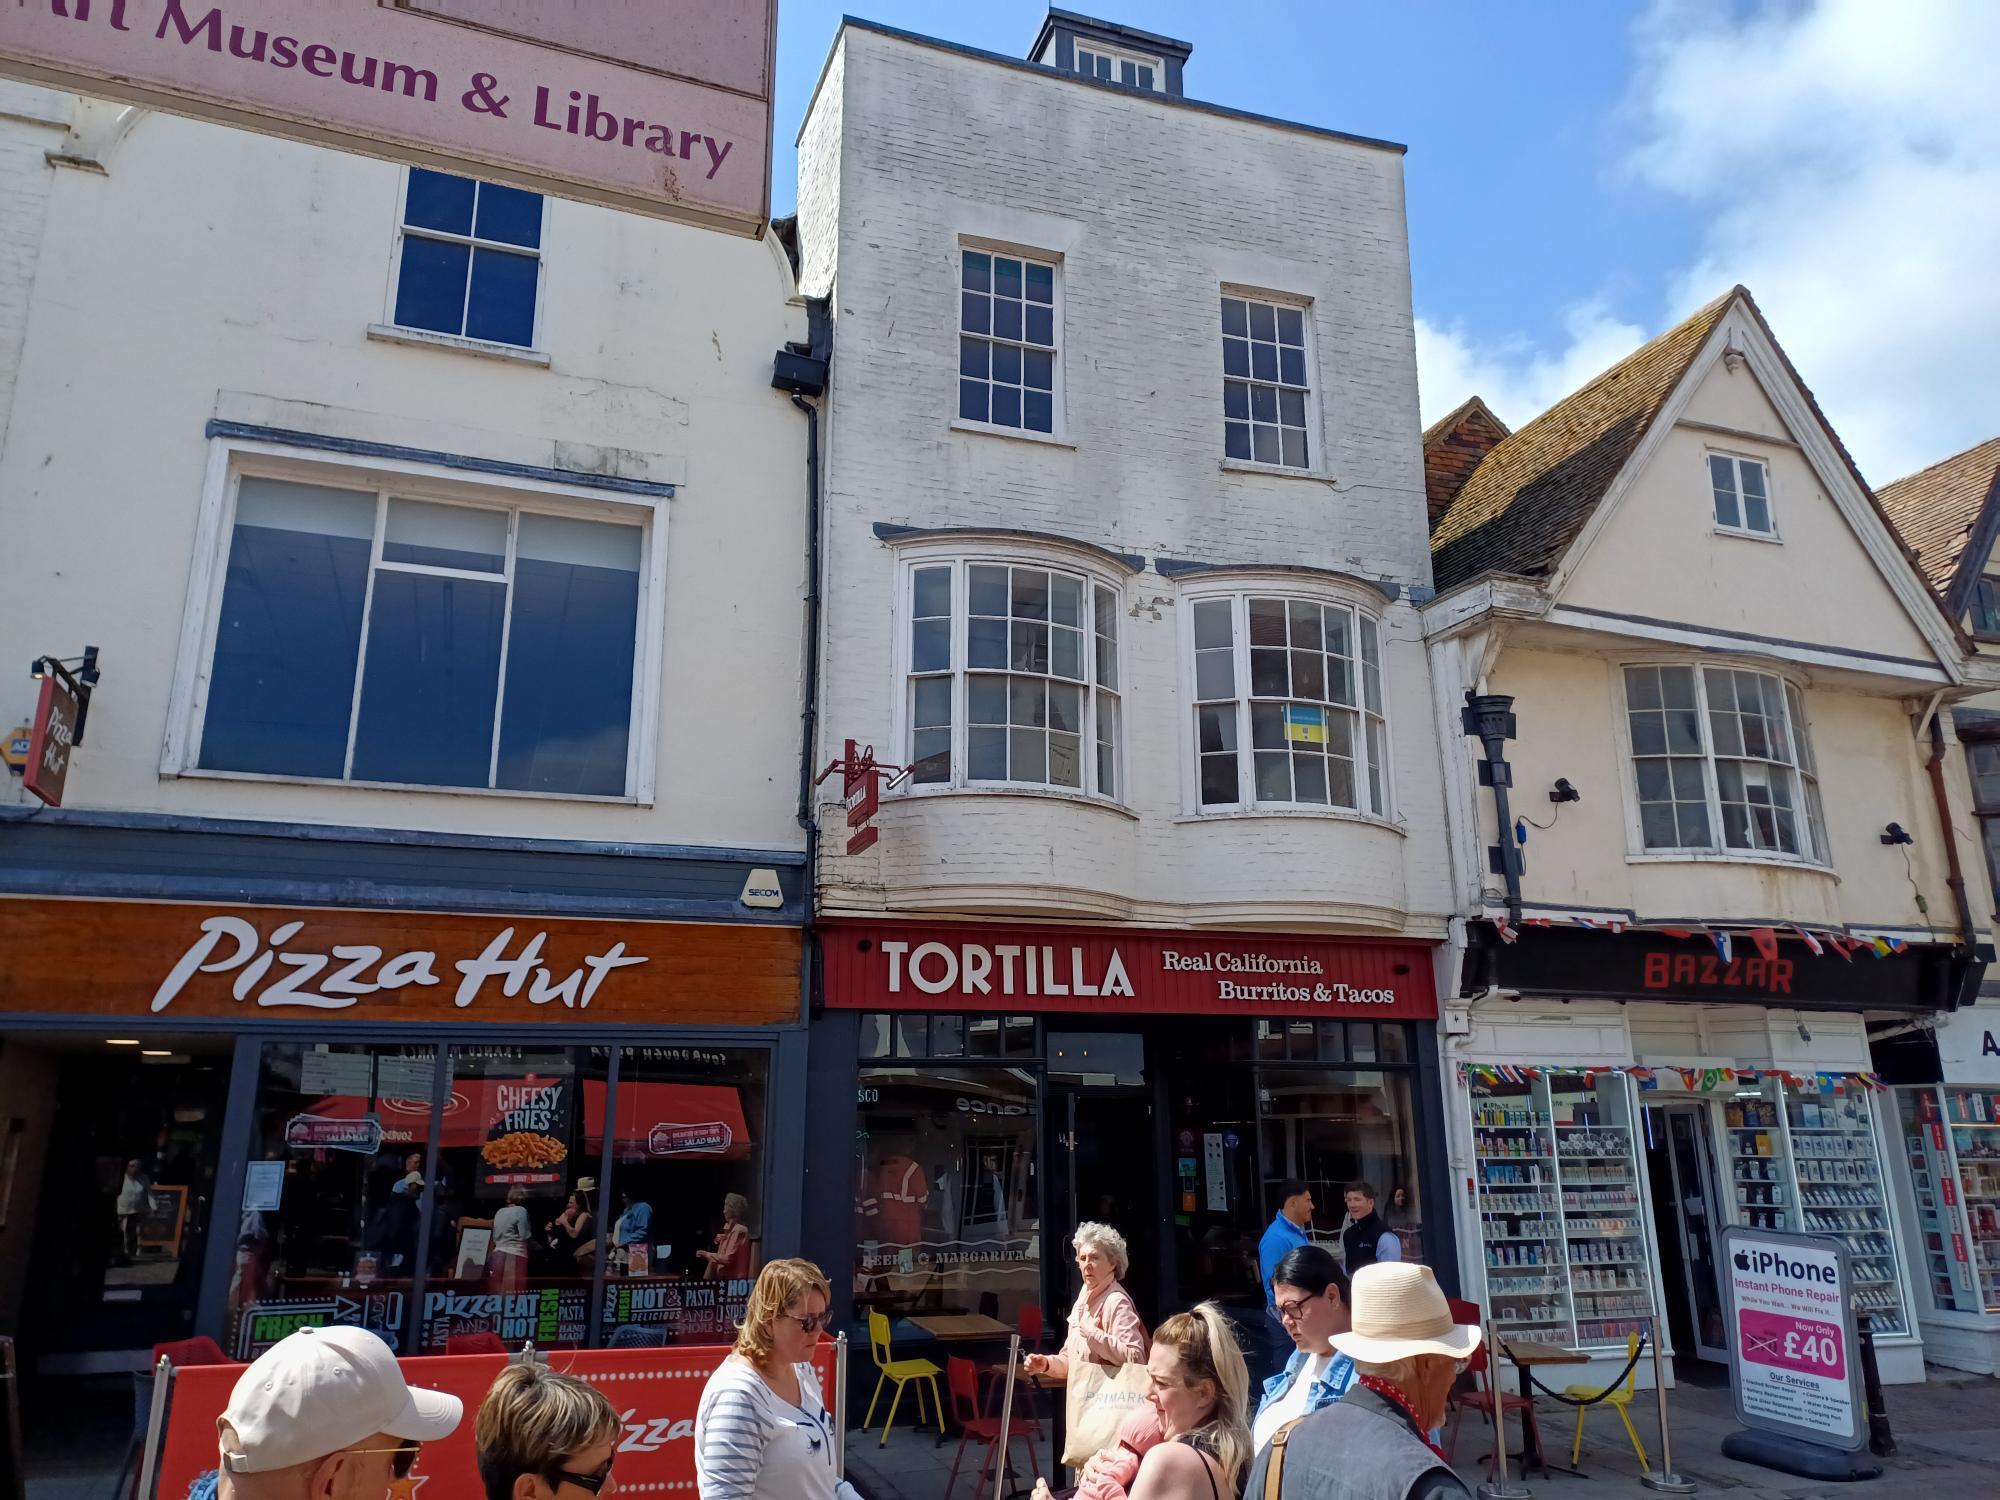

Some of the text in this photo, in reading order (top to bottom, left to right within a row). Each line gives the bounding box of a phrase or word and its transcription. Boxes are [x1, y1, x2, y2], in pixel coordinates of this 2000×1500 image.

[155, 0, 438, 102] Museum
[460, 72, 510, 118] &
[533, 86, 733, 180] Library
[46, 706, 73, 746] Pizza
[43, 741, 65, 776] Hut
[748, 888, 779, 898] SECOM
[151, 916, 650, 1012] Pizza Hut
[882, 941, 1135, 997] TORTILLA
[1162, 950, 1323, 975] Real California
[1645, 952, 1793, 993] BAZZAR
[1218, 981, 1395, 1005] Burritos & Tacos
[497, 1085, 563, 1111] CHEESY
[504, 1109, 552, 1132] FRIES
[1752, 1250, 1836, 1284] iPhone
[631, 1288, 667, 1309] HOT
[685, 1289, 715, 1307] PASTA
[1735, 1278, 1840, 1303] Instant Phone Repair
[424, 1289, 503, 1318] Pizza
[504, 1294, 540, 1318] EAT
[538, 1289, 560, 1341] FRESH
[558, 1306, 585, 1321] PASTA
[602, 1284, 618, 1323] Pizza
[617, 1289, 631, 1322] FRESH
[253, 1312, 325, 1341] FRESH
[453, 1318, 490, 1334] AND
[502, 1317, 538, 1339] HOT
[631, 1311, 681, 1322] DELICIOUS
[682, 1309, 714, 1323] AND
[558, 1332, 586, 1341] MADE
[559, 1325, 587, 1334] HAND
[1795, 1321, 1835, 1338] Now Only
[1783, 1331, 1838, 1367] £40
[1769, 1371, 1820, 1389] Our Services
[1086, 1391, 1147, 1404] PRIMARK
